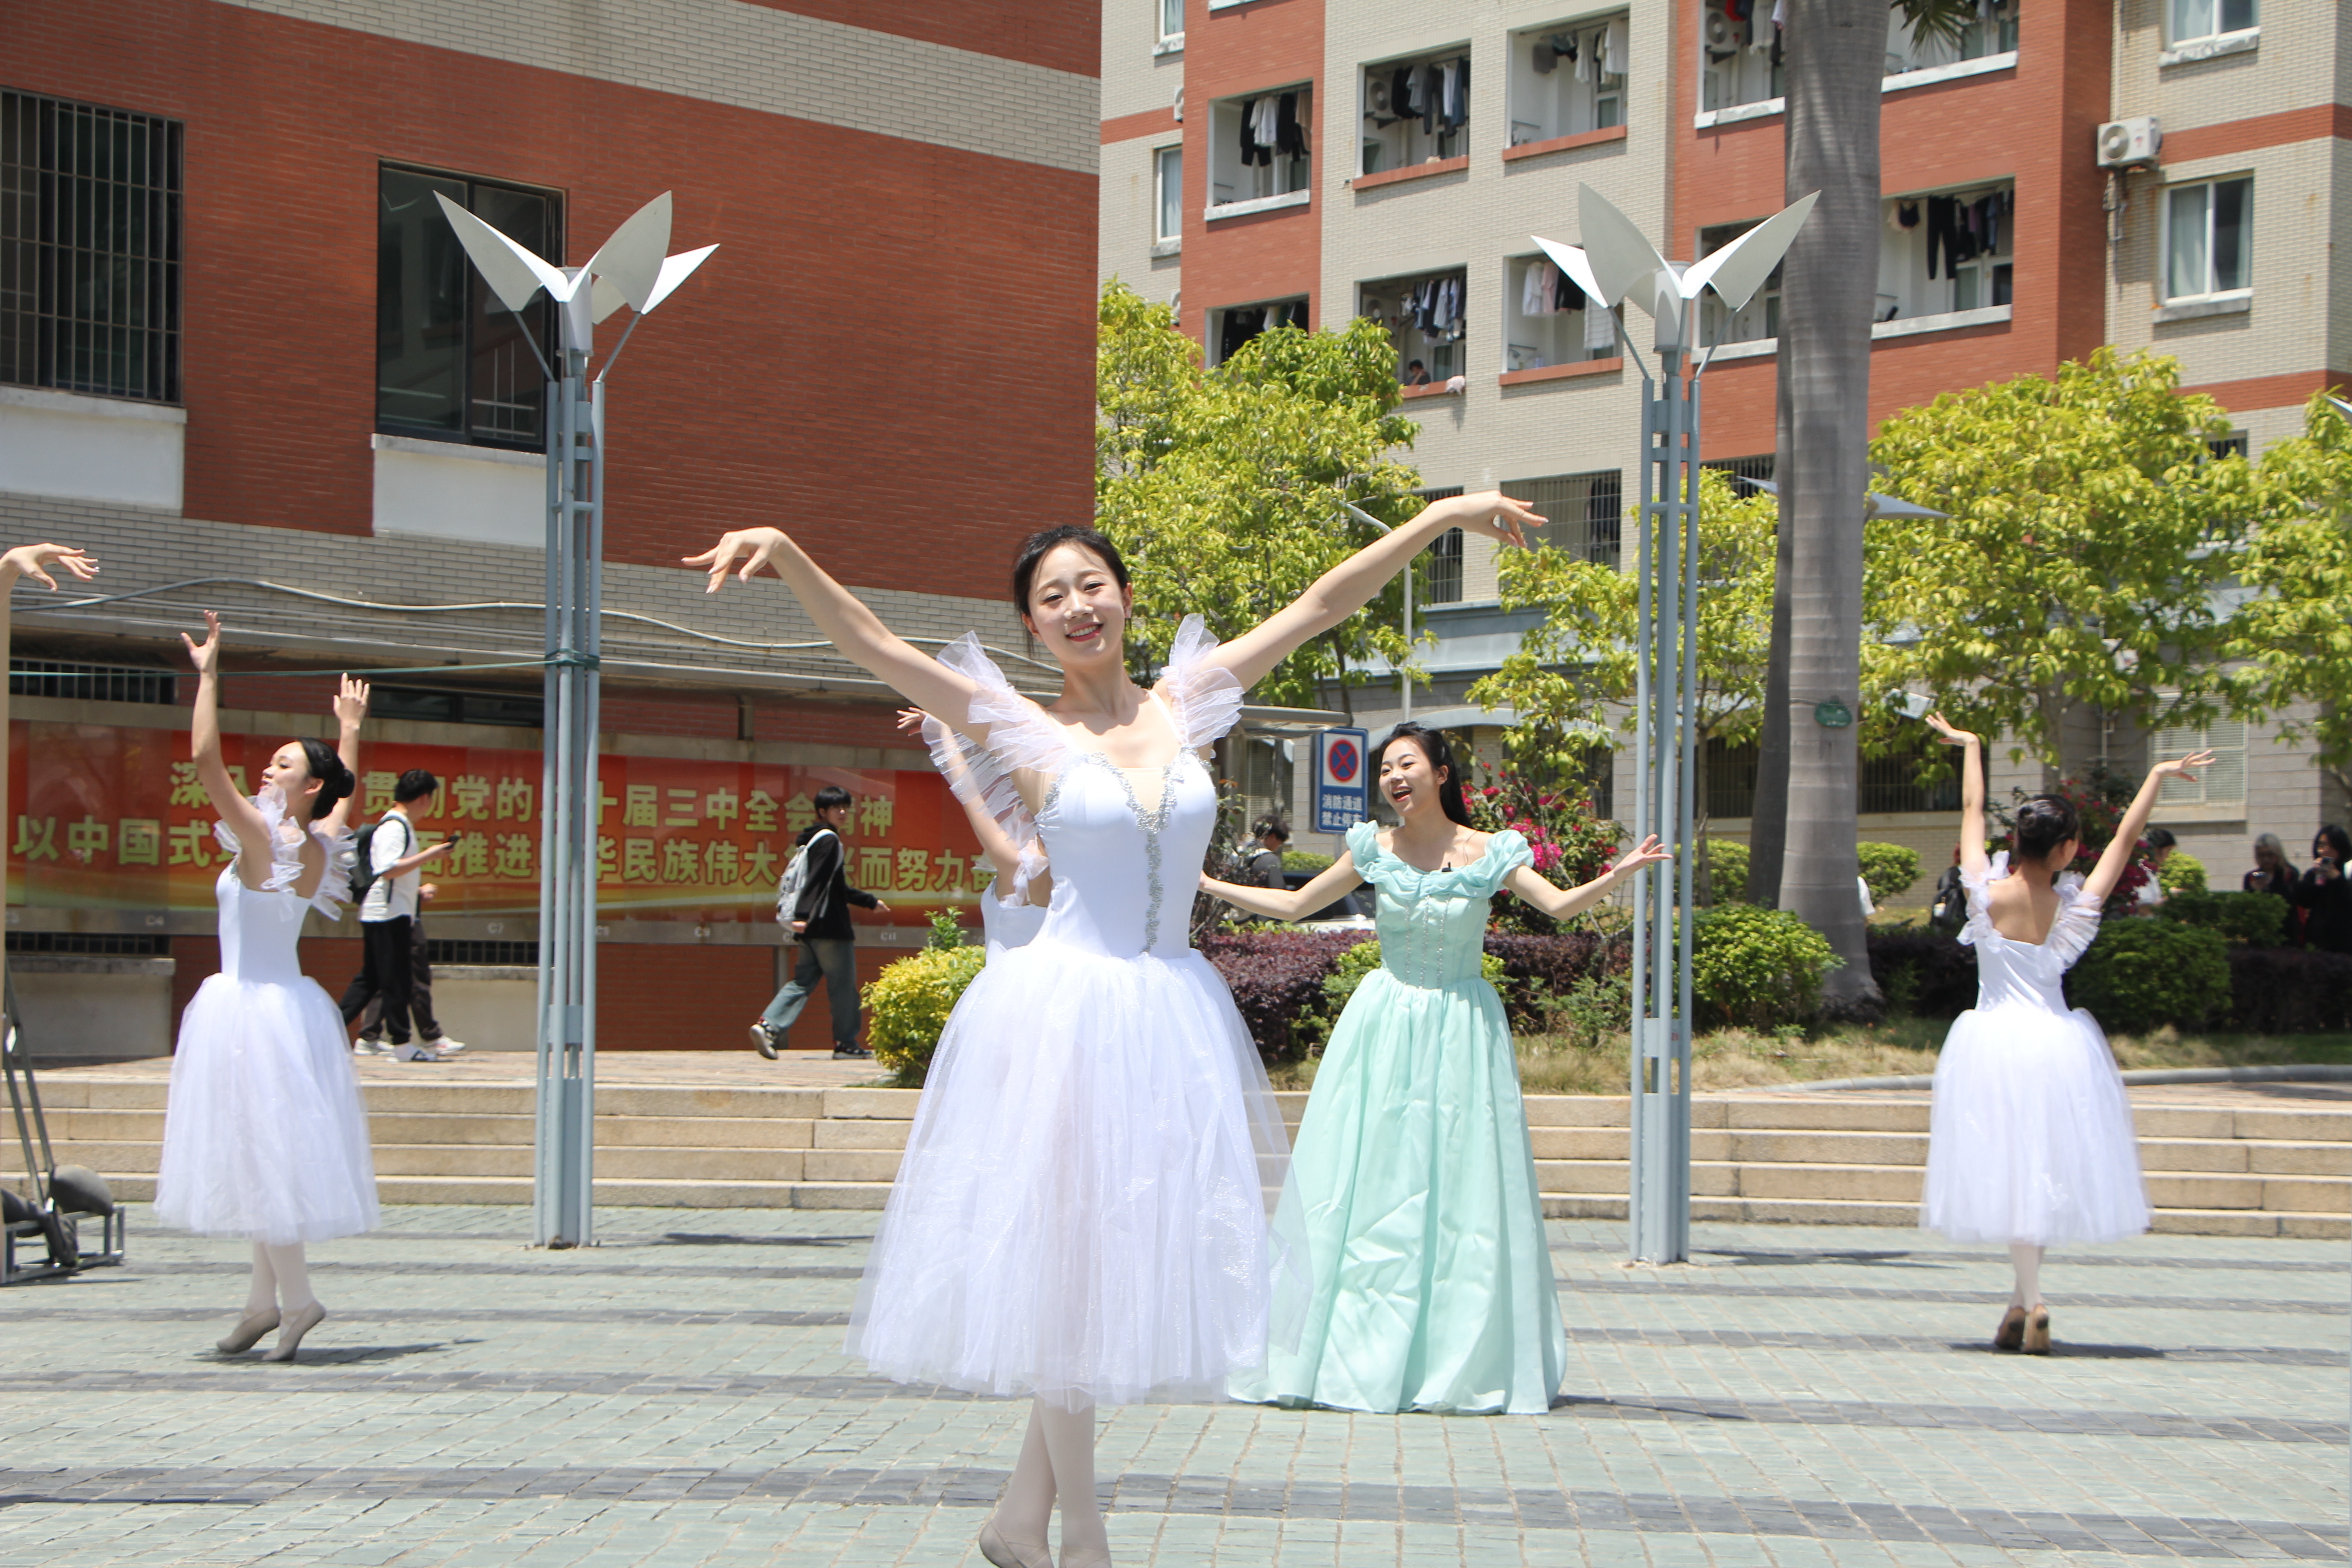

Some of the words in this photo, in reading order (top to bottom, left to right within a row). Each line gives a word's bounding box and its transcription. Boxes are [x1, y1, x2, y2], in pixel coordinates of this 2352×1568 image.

[1322, 794, 1362, 811] 消防通道
[145, 914, 164, 927] C4
[487, 922, 505, 934] C7
